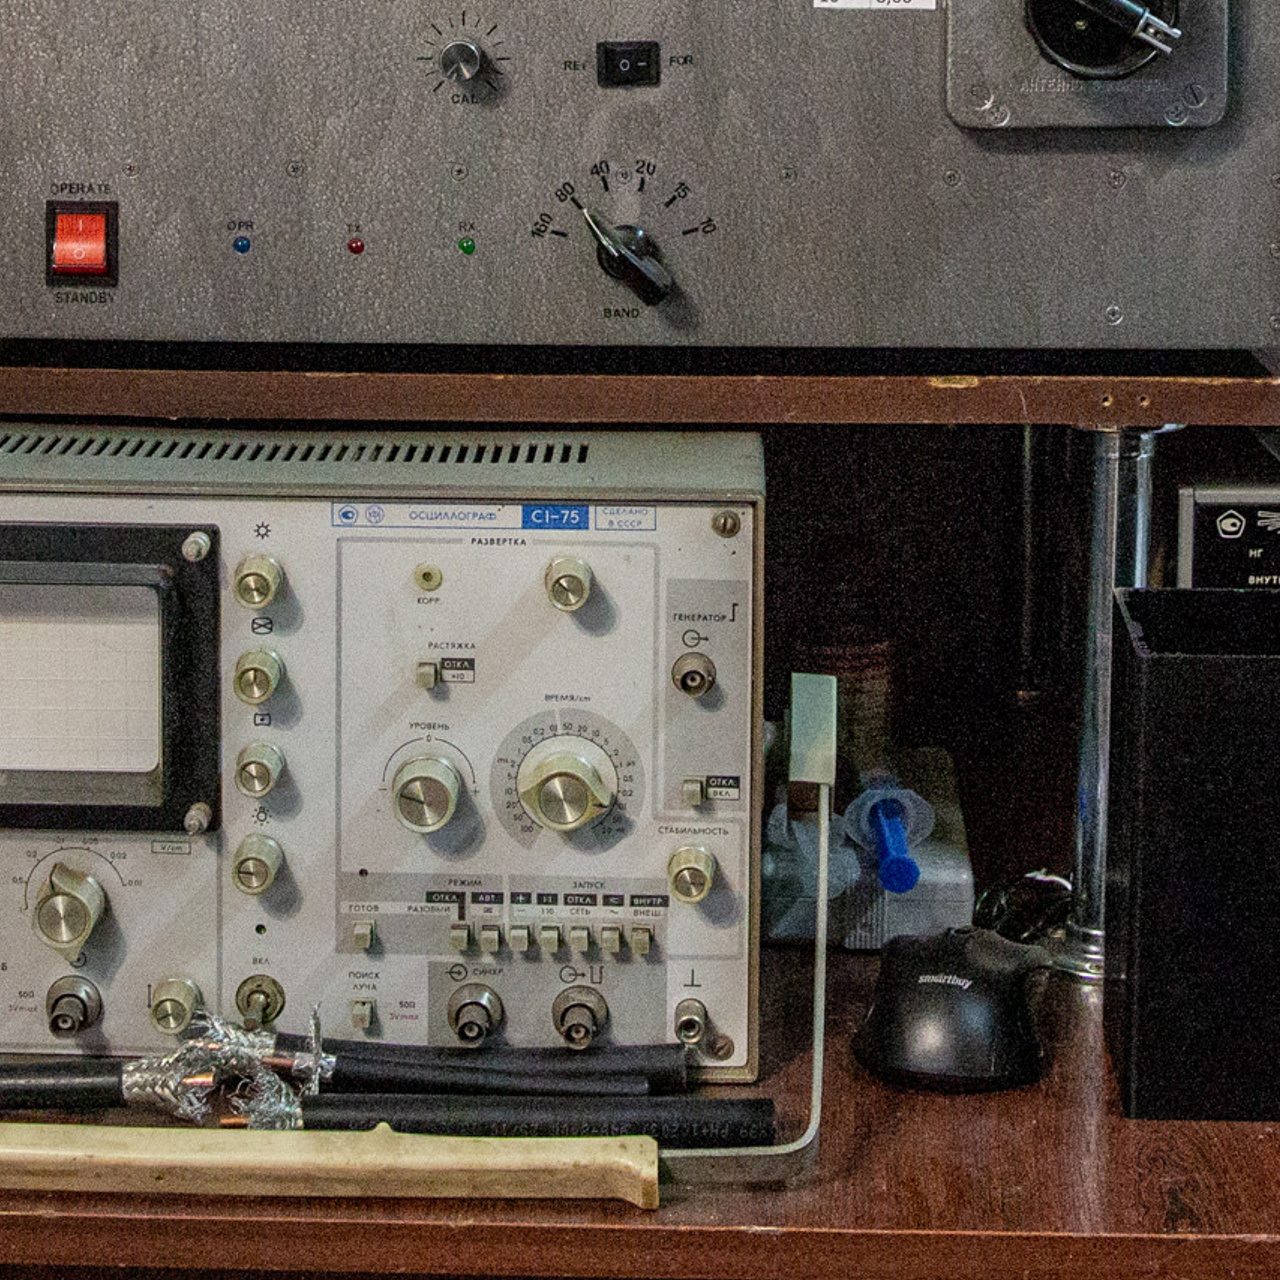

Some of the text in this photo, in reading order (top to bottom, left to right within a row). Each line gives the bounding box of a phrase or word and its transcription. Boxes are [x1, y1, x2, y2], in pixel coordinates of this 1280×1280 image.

[669, 55, 693, 67] FOR
[451, 93, 479, 104] CAL
[590, 160, 611, 176] 40
[635, 159, 656, 176] 20
[51, 183, 110, 195] OPERATE
[555, 182, 575, 203] 80
[674, 181, 692, 199] 15
[458, 221, 475, 231] RX
[531, 212, 554, 239] 160
[701, 217, 716, 235] 10
[56, 291, 115, 304] STANDBY
[603, 308, 640, 319] BAND
[409, 510, 497, 521] ОСЦИЛЛОГРАФ
[602, 507, 649, 517] СДЕЛАНО
[617, 520, 642, 528] СССР
[471, 538, 527, 546] РАЗВЕРТКА
[673, 613, 727, 622] ГЕНЕРАТОР
[428, 641, 476, 650] РАСТЯЖКА
[409, 722, 450, 730] УРОВЕНЬ
[658, 826, 729, 836] СТАБИЛЬНОСТЬ
[448, 879, 482, 887] РЕЖИМ
[572, 881, 605, 889] ЗАПУСК
[349, 905, 379, 913] ГОТОВ
[570, 908, 590, 916] СЕТЬ
[252, 957, 270, 965] ВКЛ
[349, 972, 380, 980] ПОИСК
[918, 973, 973, 990] smartbuy
